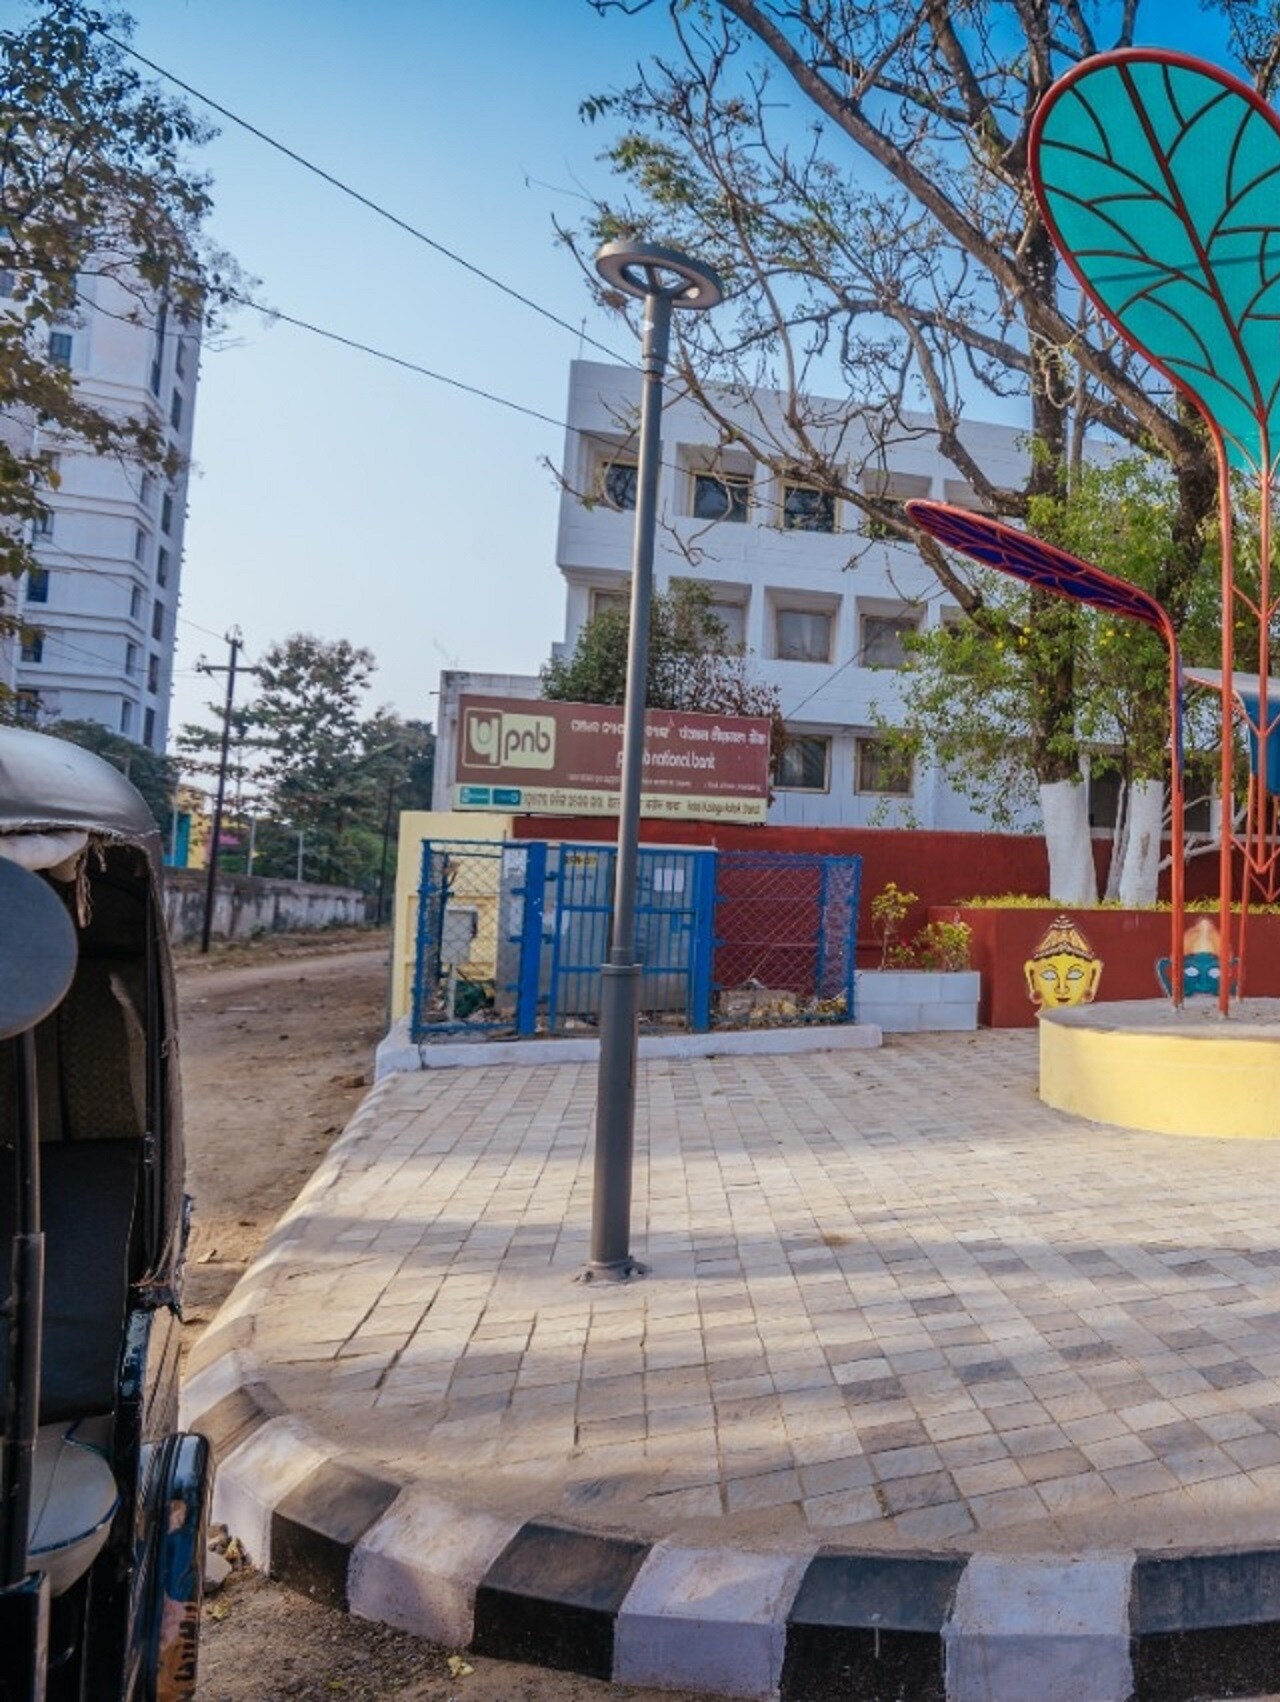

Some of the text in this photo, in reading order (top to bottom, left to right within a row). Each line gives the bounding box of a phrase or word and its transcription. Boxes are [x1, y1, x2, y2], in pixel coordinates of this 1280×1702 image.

[504, 721, 551, 761] pnb
[652, 749, 690, 767] national
[692, 750, 716, 769] bank
